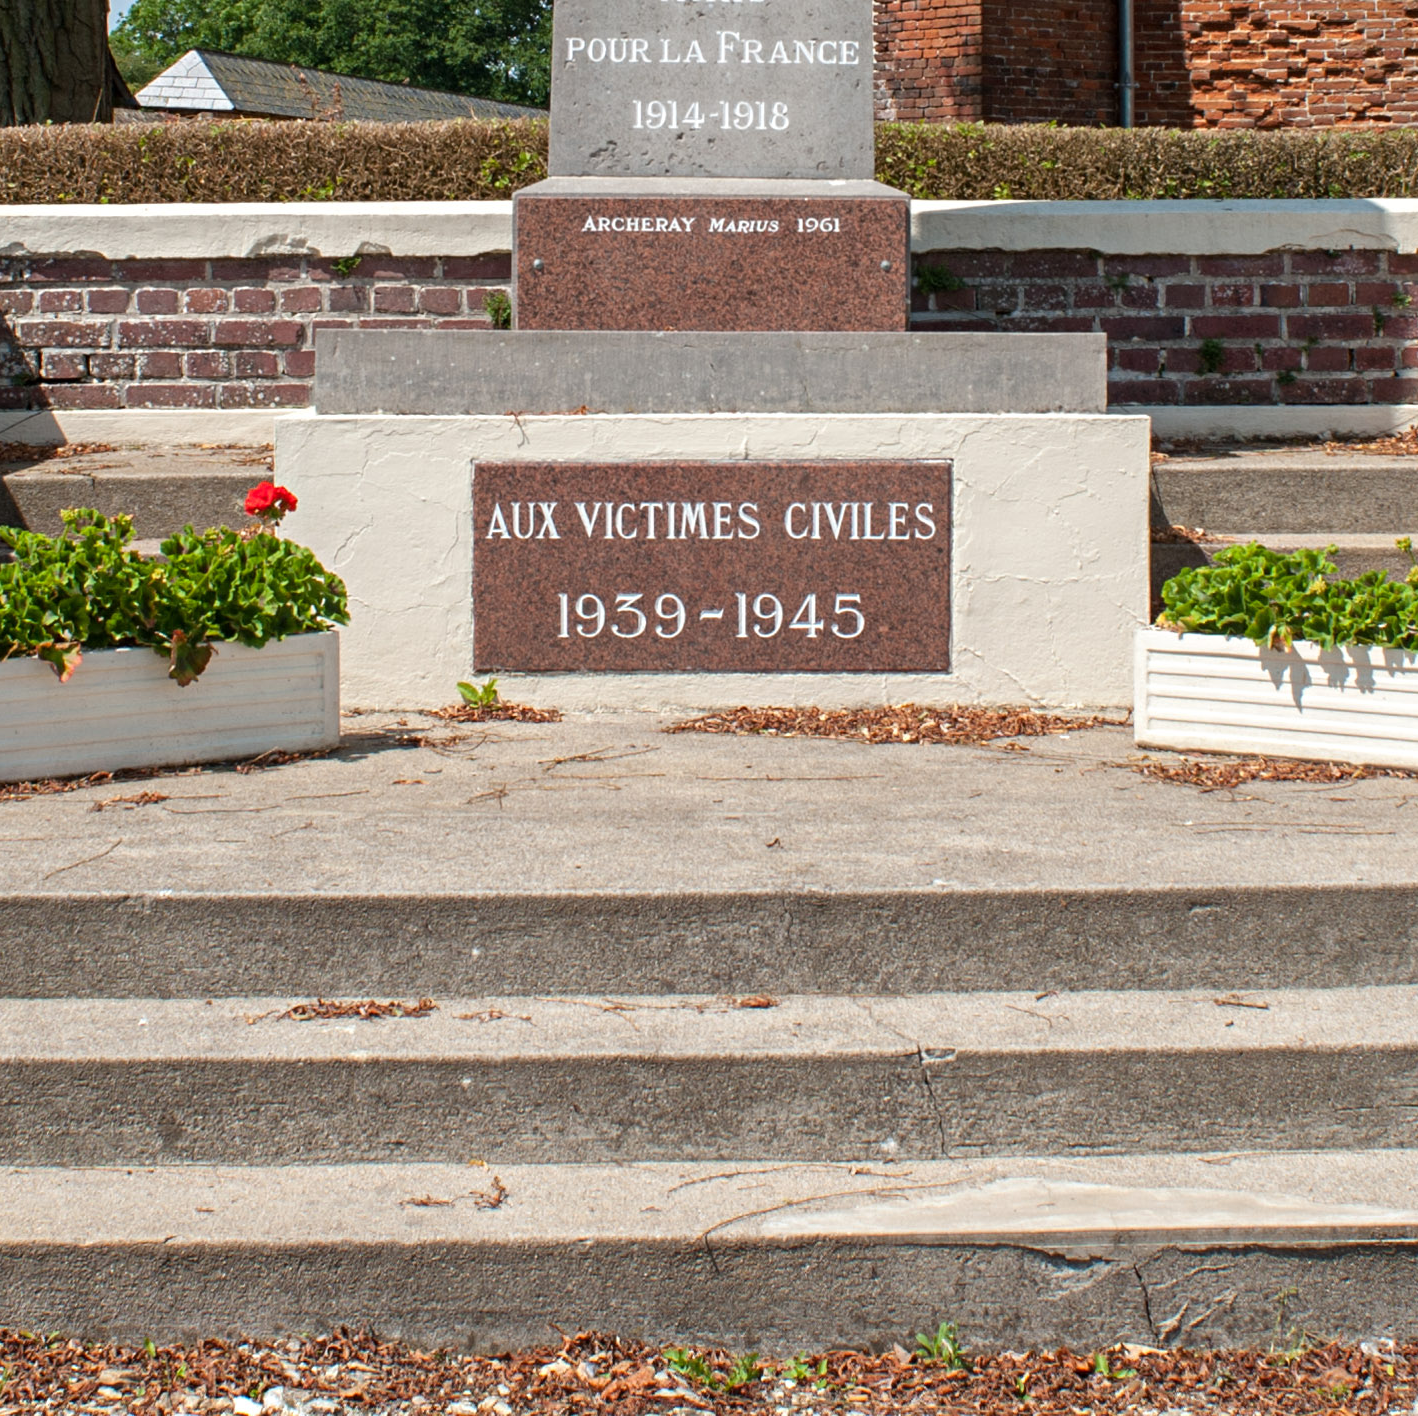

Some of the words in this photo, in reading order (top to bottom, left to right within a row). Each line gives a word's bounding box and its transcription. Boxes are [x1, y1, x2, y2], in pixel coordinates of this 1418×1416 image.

[565, 36, 653, 64] POUR
[659, 36, 707, 65] LA
[631, 99, 791, 132] 1914-1918
[796, 217, 841, 234] 1961
[485, 500, 562, 541] AUX
[574, 500, 761, 541] VICTIMES
[784, 501, 937, 541] CIVILES
[557, 591, 865, 640] 1939-1945
